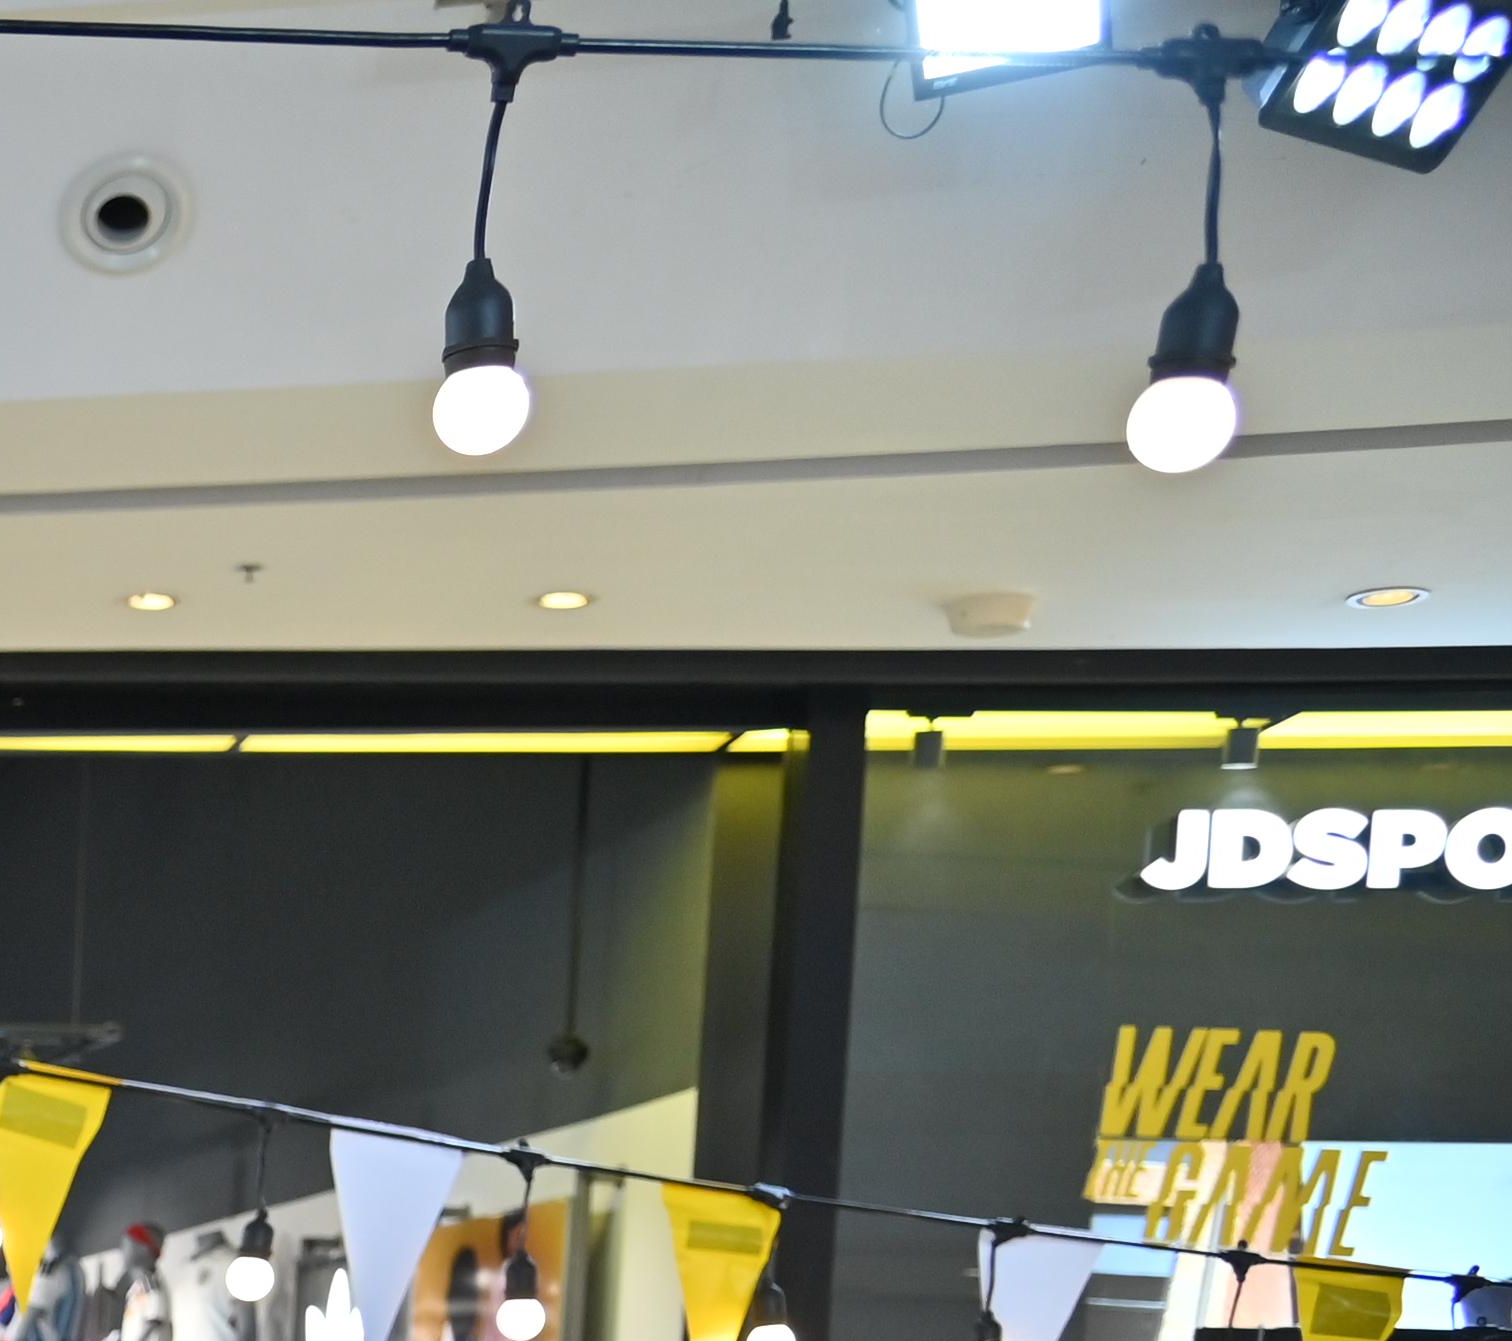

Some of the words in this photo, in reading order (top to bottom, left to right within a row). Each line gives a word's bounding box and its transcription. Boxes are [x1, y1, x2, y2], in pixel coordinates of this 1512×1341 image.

[1141, 807, 1512, 890] JDSPO
[1098, 1024, 1336, 1142] WEAR
[1143, 1142, 1388, 1256] GAME
